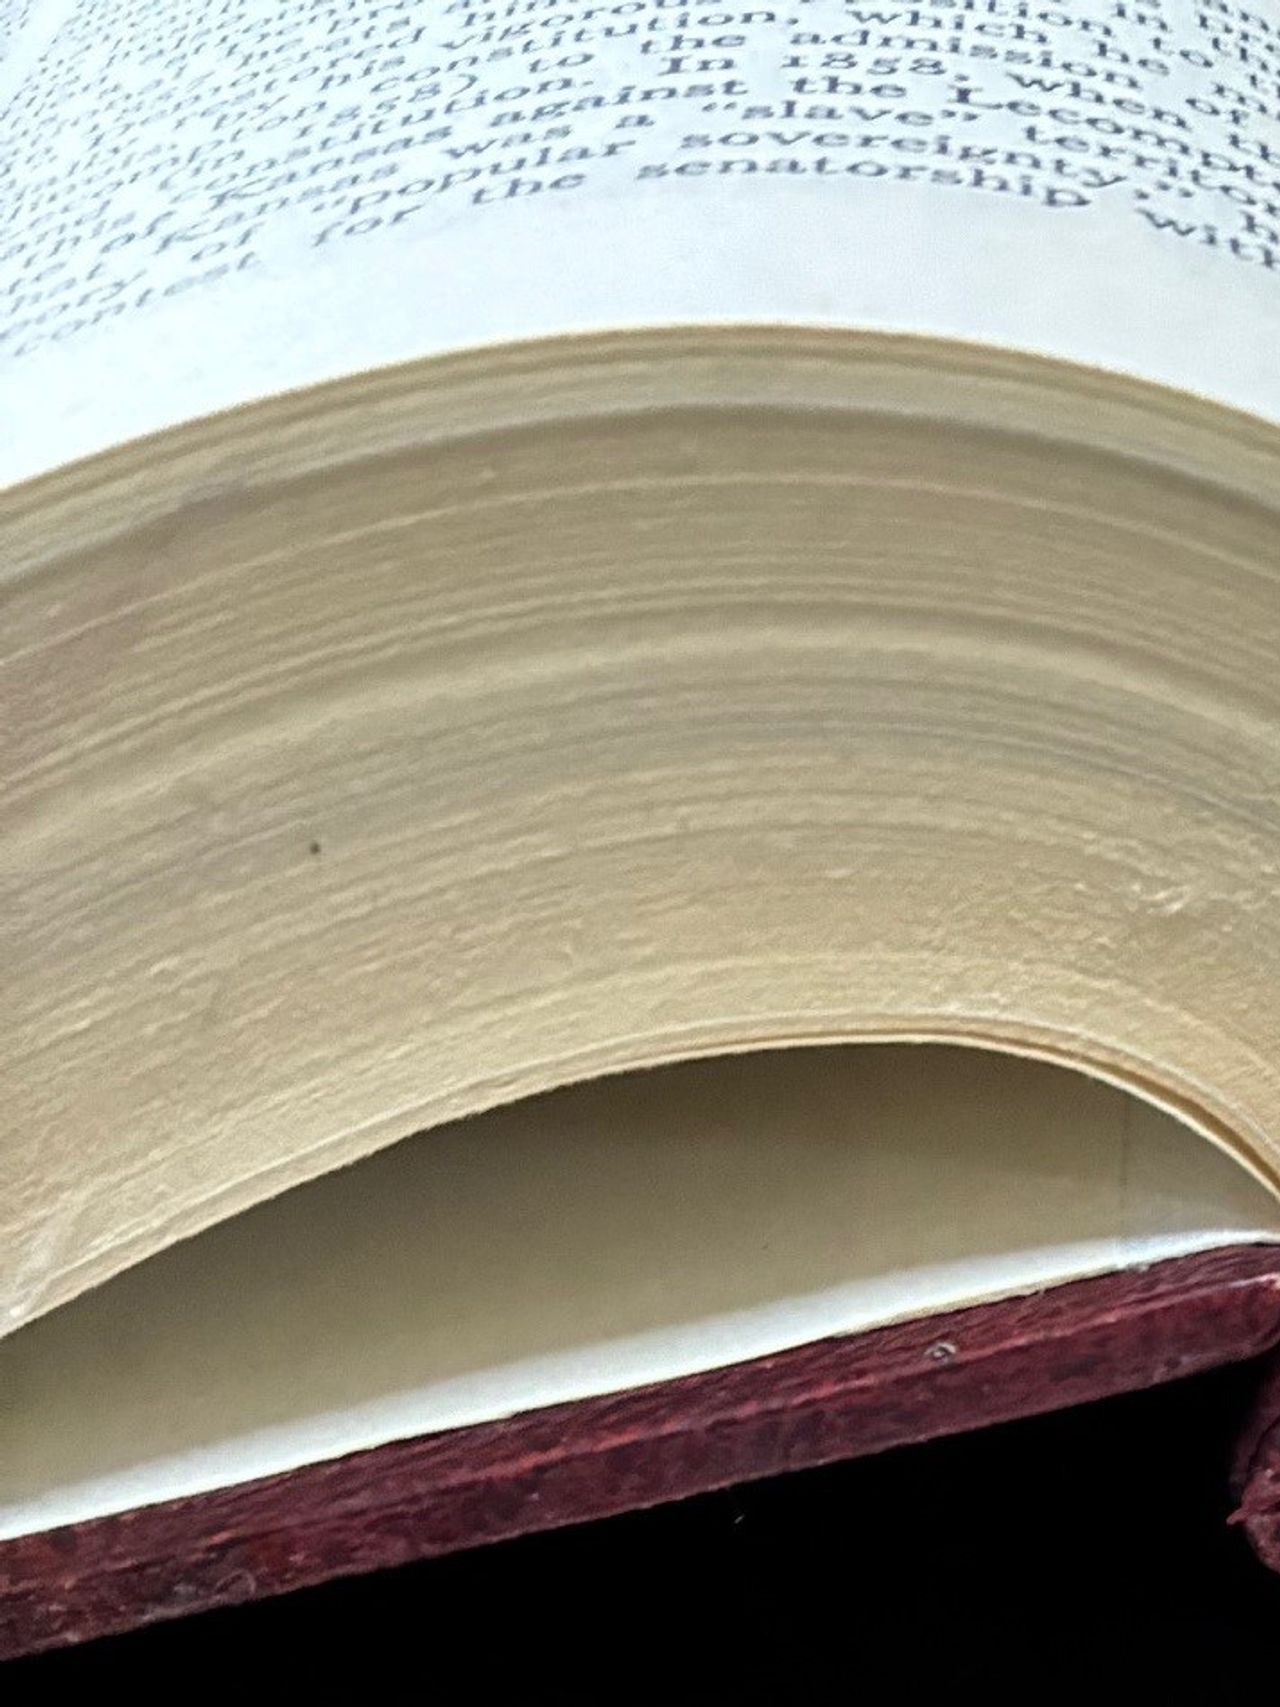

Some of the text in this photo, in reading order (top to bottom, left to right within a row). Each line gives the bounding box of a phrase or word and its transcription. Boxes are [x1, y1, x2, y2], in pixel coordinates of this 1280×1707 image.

[528, 52, 595, 74] to
[639, 33, 747, 55] the
[789, 29, 1141, 90] admission
[657, 55, 736, 76] In
[488, 78, 749, 128] against
[791, 75, 908, 99] the
[440, 123, 573, 160] was
[615, 113, 656, 130] a
[311, 202, 426, 249] for
[472, 173, 588, 205] the
[634, 156, 1092, 208] senatorship
